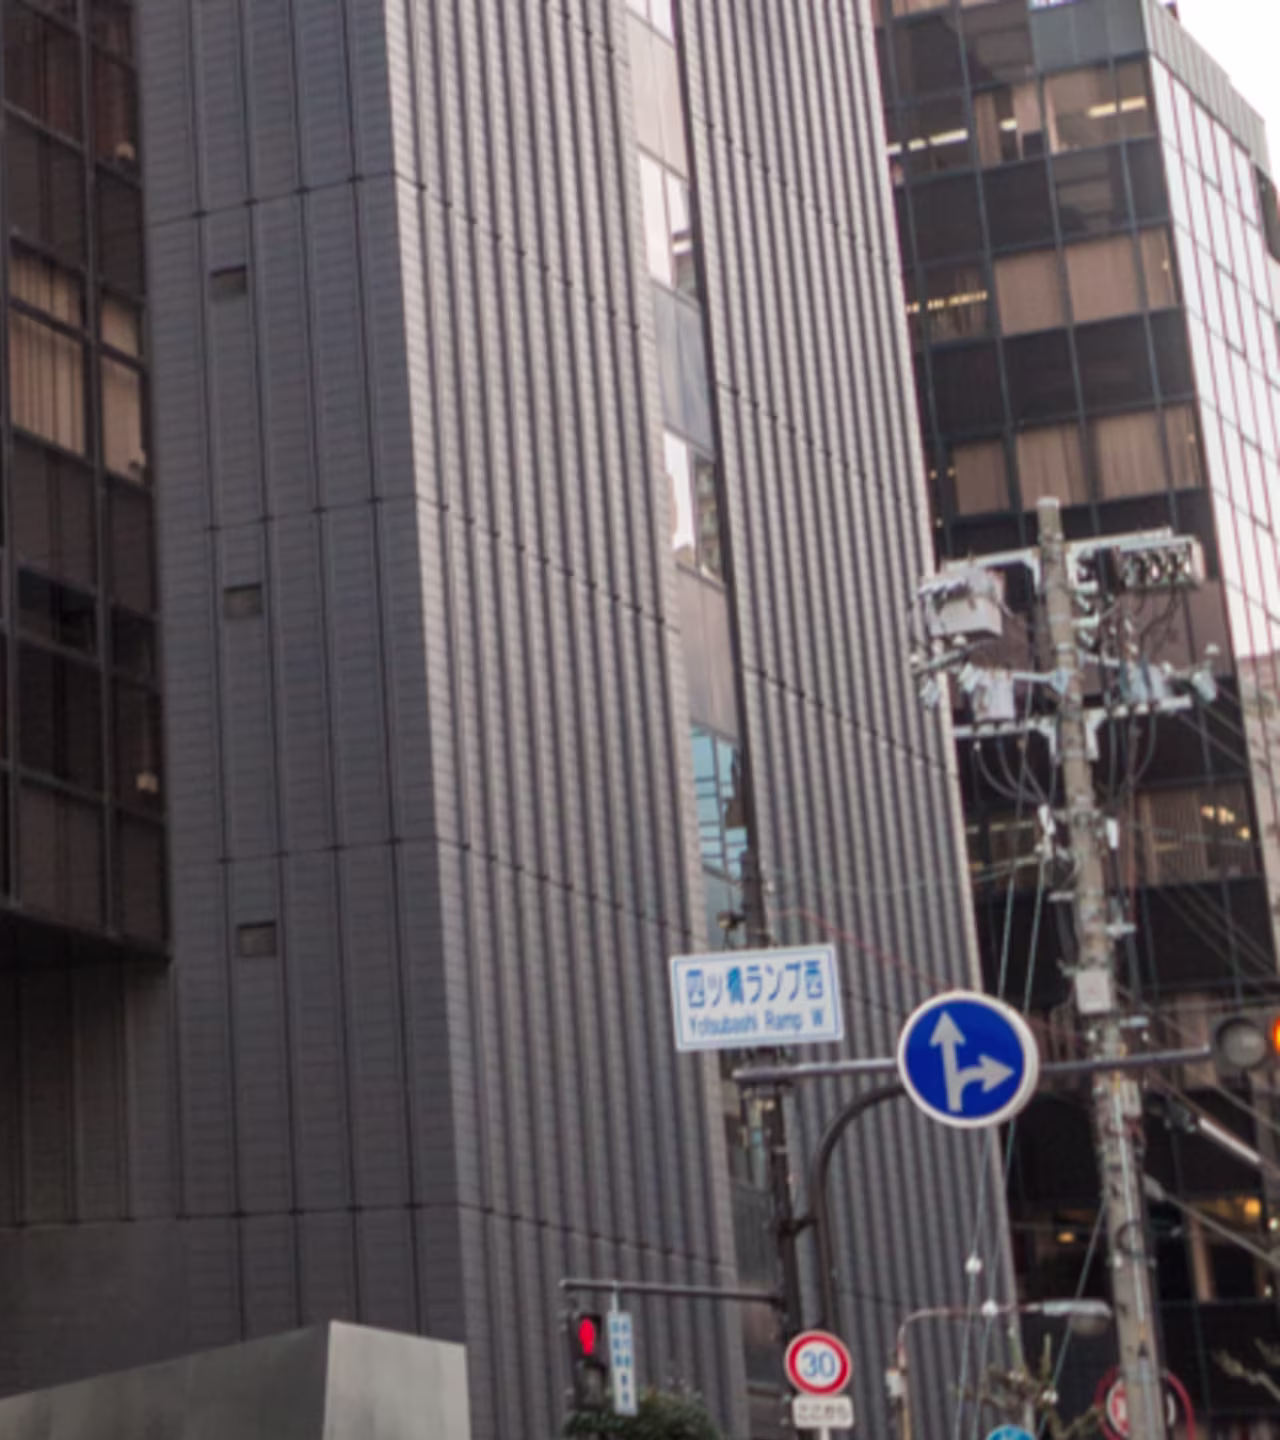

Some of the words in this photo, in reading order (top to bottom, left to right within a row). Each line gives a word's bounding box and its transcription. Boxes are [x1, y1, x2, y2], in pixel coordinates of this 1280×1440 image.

[686, 959, 824, 1009] 四ツ橋ランプ西
[690, 1012, 759, 1036] Yotsubashi
[765, 1009, 803, 1032] Ramp
[812, 1008, 824, 1027] W
[802, 1350, 836, 1377] 30
